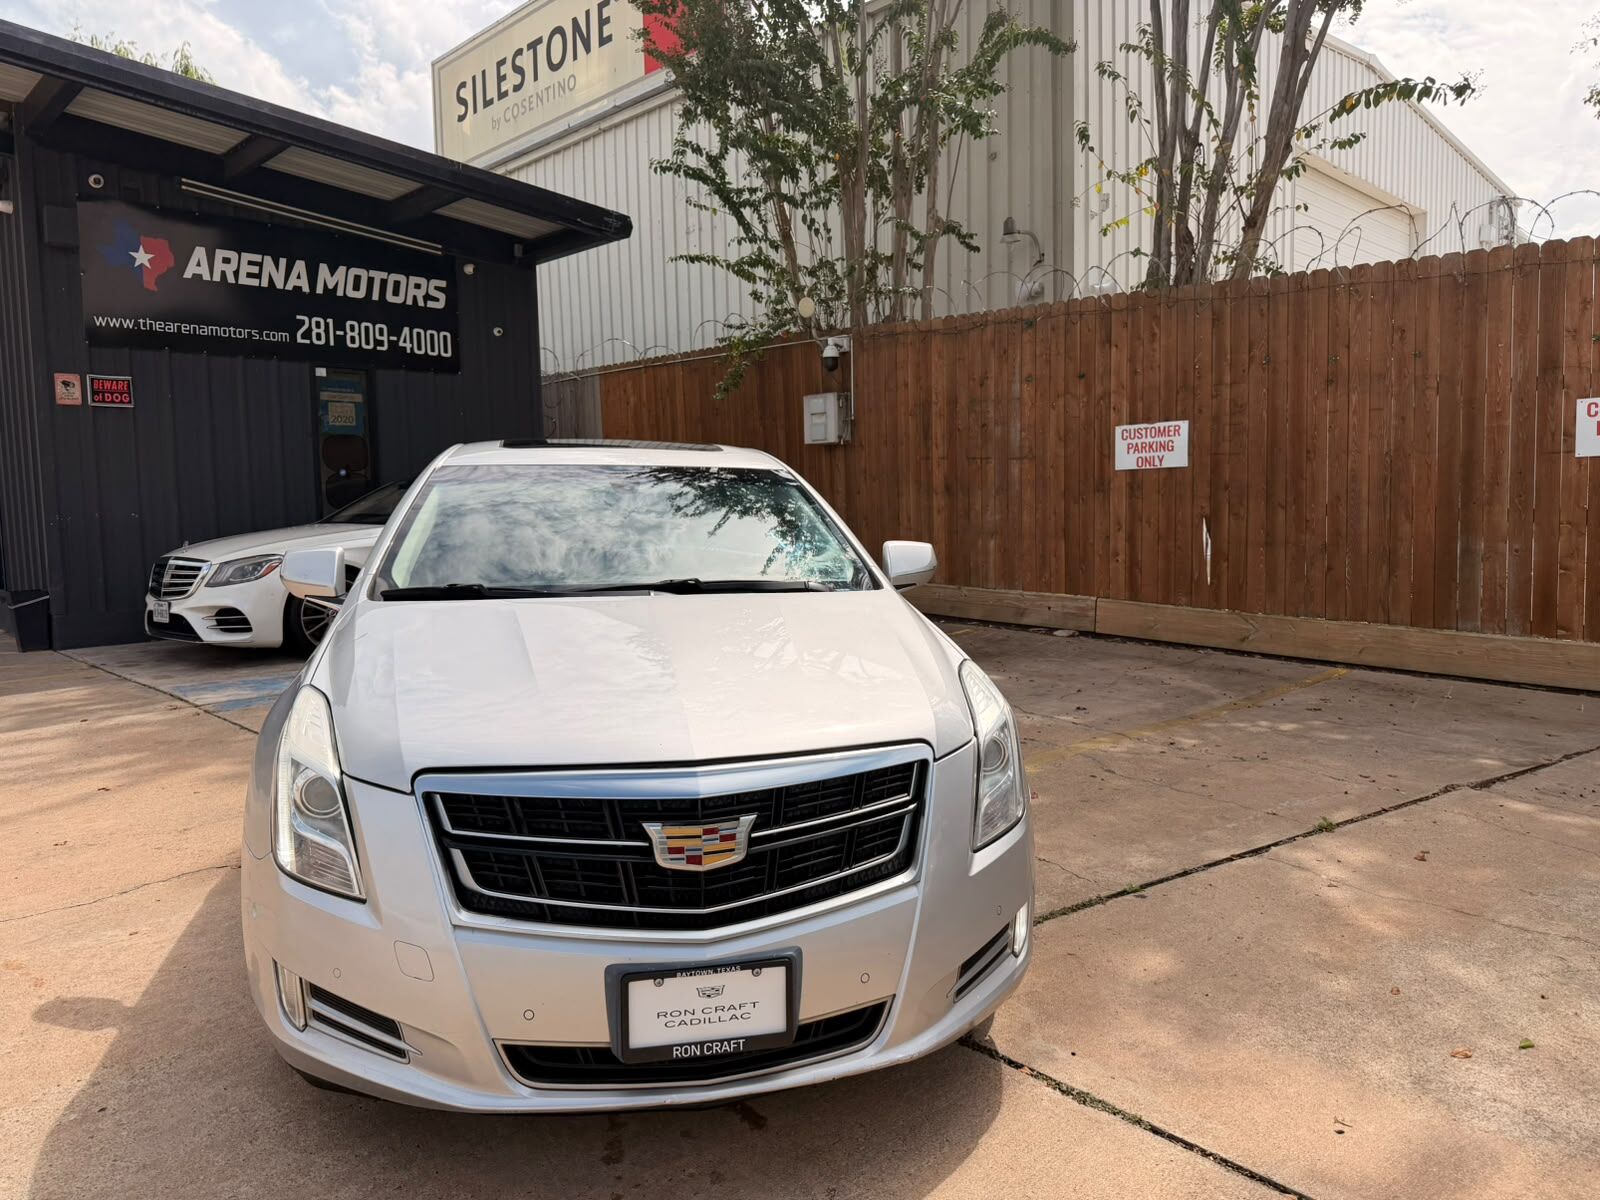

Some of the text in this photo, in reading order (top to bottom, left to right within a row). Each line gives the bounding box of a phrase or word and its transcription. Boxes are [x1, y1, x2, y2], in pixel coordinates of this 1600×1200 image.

[456, 0, 613, 123] SILESTONE
[491, 74, 576, 131] by COSENTINO
[183, 246, 447, 310] ARENA MOTORS
[93, 315, 452, 358] www.thearenamotors.com 281-809-4000
[93, 380, 129, 391] BEWARE
[93, 393, 130, 402] of DOG
[330, 415, 354, 424] 2020
[1121, 425, 1181, 440] CUSTOMER
[1127, 440, 1174, 455] PARKING
[1136, 454, 1165, 468] ONLY
[717, 965, 741, 974] TEXAS
[656, 1001, 760, 1019] RON CRAFT
[664, 1012, 751, 1028] CADILLAC
[672, 1038, 746, 1059] RON CRAFT
